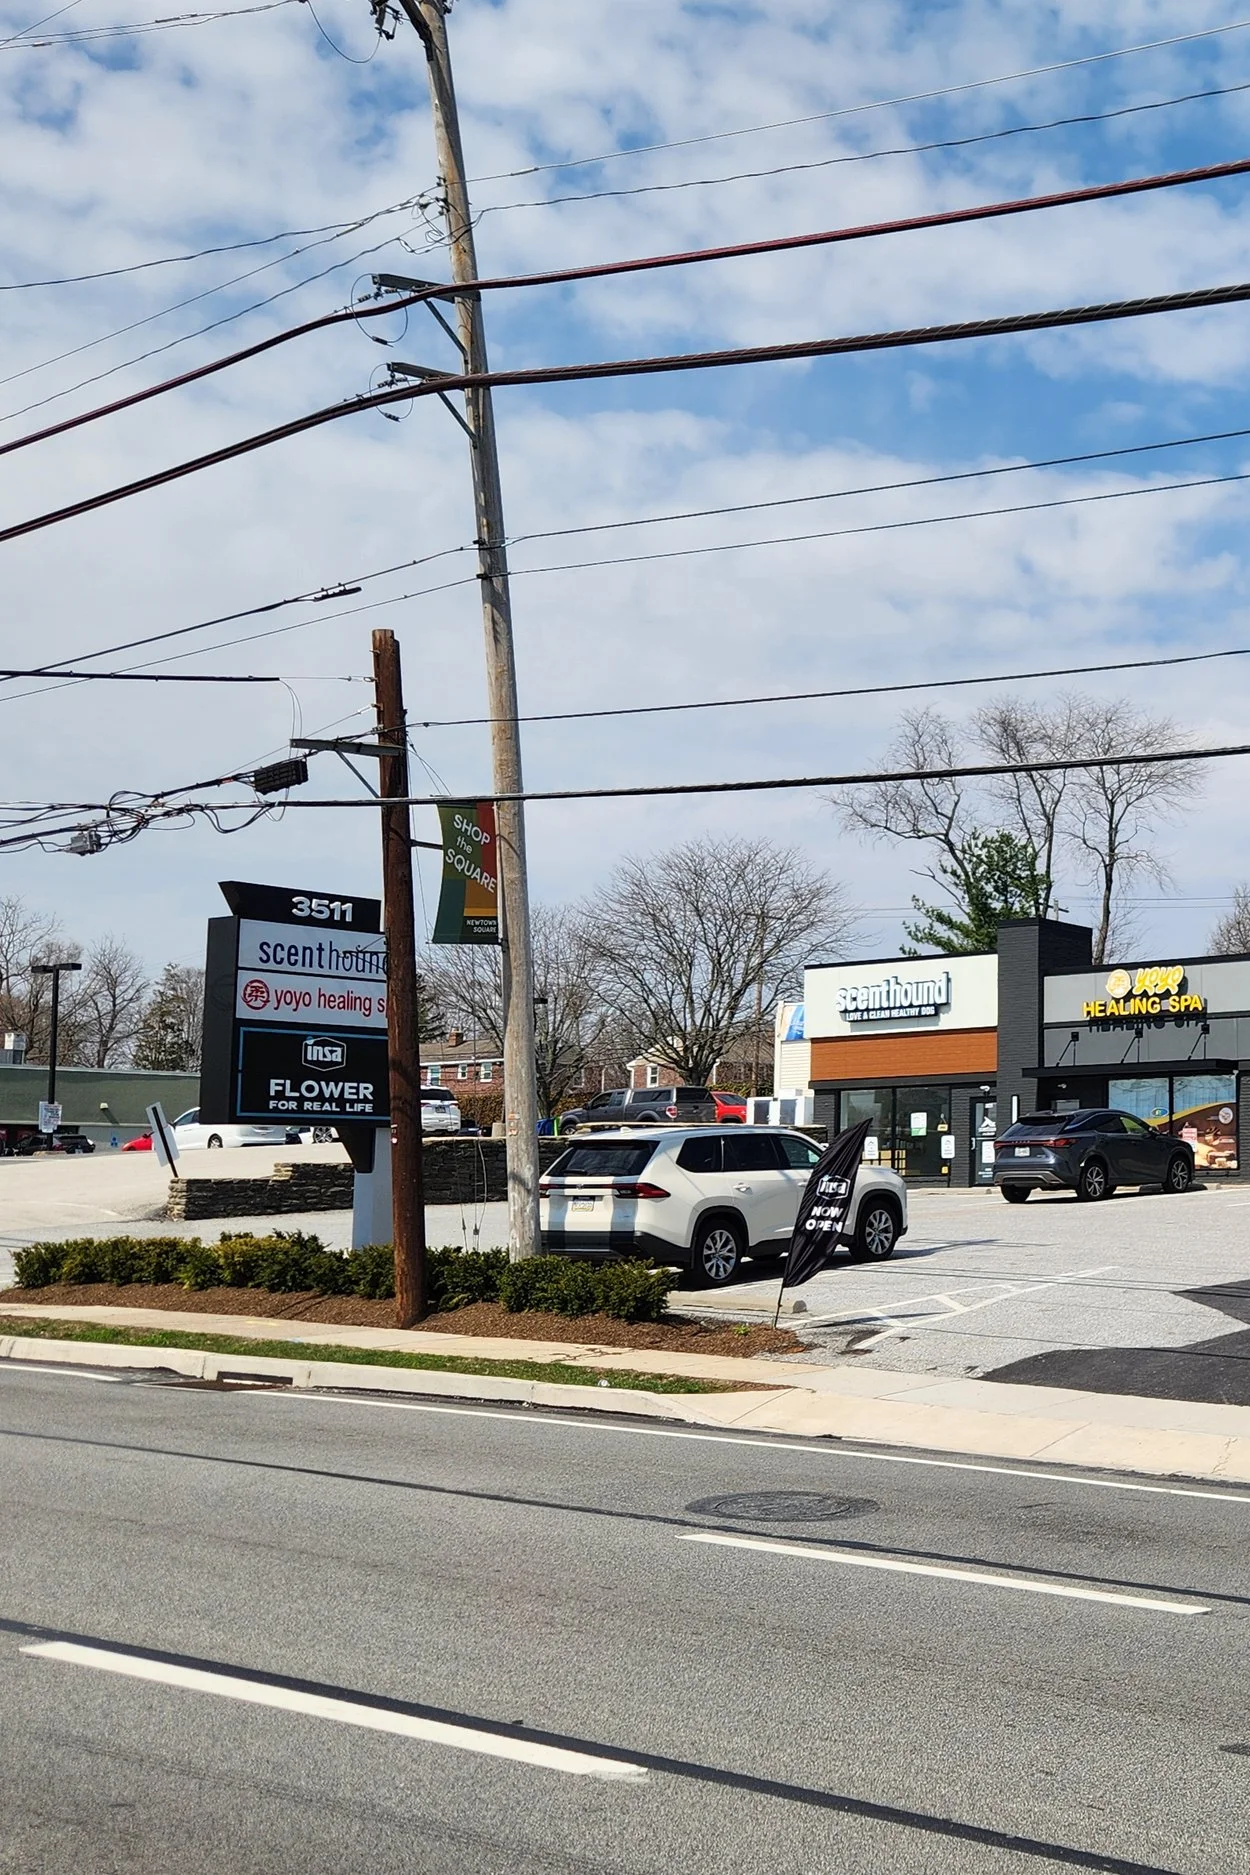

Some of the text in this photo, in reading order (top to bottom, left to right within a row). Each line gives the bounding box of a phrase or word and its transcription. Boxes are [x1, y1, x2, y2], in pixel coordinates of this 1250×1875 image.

[453, 814, 491, 846] SHOP
[456, 835, 473, 854] the
[445, 848, 497, 893] SQUARE
[292, 896, 353, 922] 3511
[466, 919, 497, 927] NEWTOWN
[273, 988, 312, 1012] yoyo
[318, 987, 372, 1017] healing
[836, 971, 950, 1012] scenthound
[846, 1006, 936, 1021] LOVE A CLEAN HEALTHY DOG
[1083, 994, 1204, 1018] HEALING SPA
[305, 1036, 343, 1062] insa
[269, 1079, 374, 1100] FLOWER
[269, 1100, 374, 1113] FOR REAL LIFE
[811, 1206, 843, 1218] NOW
[805, 1219, 843, 1233] OPEN
